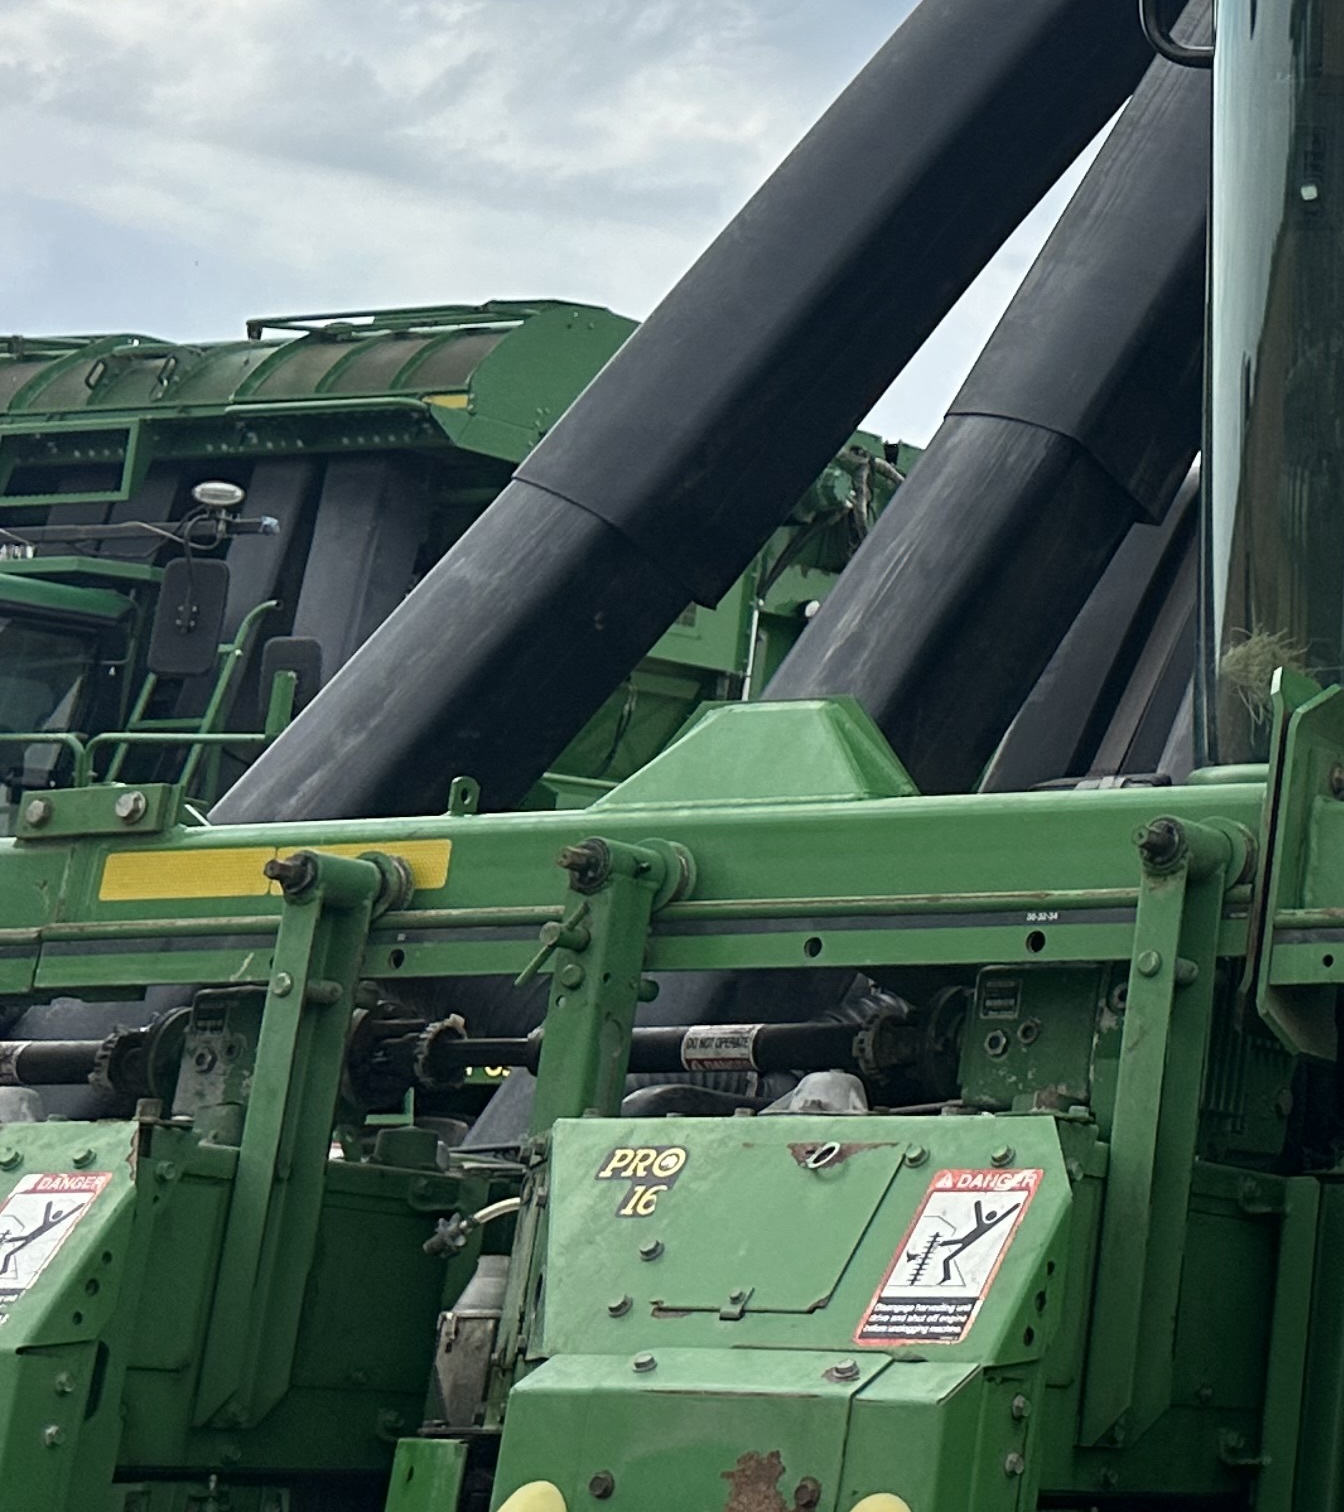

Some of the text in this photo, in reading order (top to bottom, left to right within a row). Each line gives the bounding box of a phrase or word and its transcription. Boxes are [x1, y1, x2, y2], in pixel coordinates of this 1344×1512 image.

[598, 1147, 686, 1178] PRO
[35, 1174, 108, 1191] DANGER
[620, 1185, 668, 1216] 16
